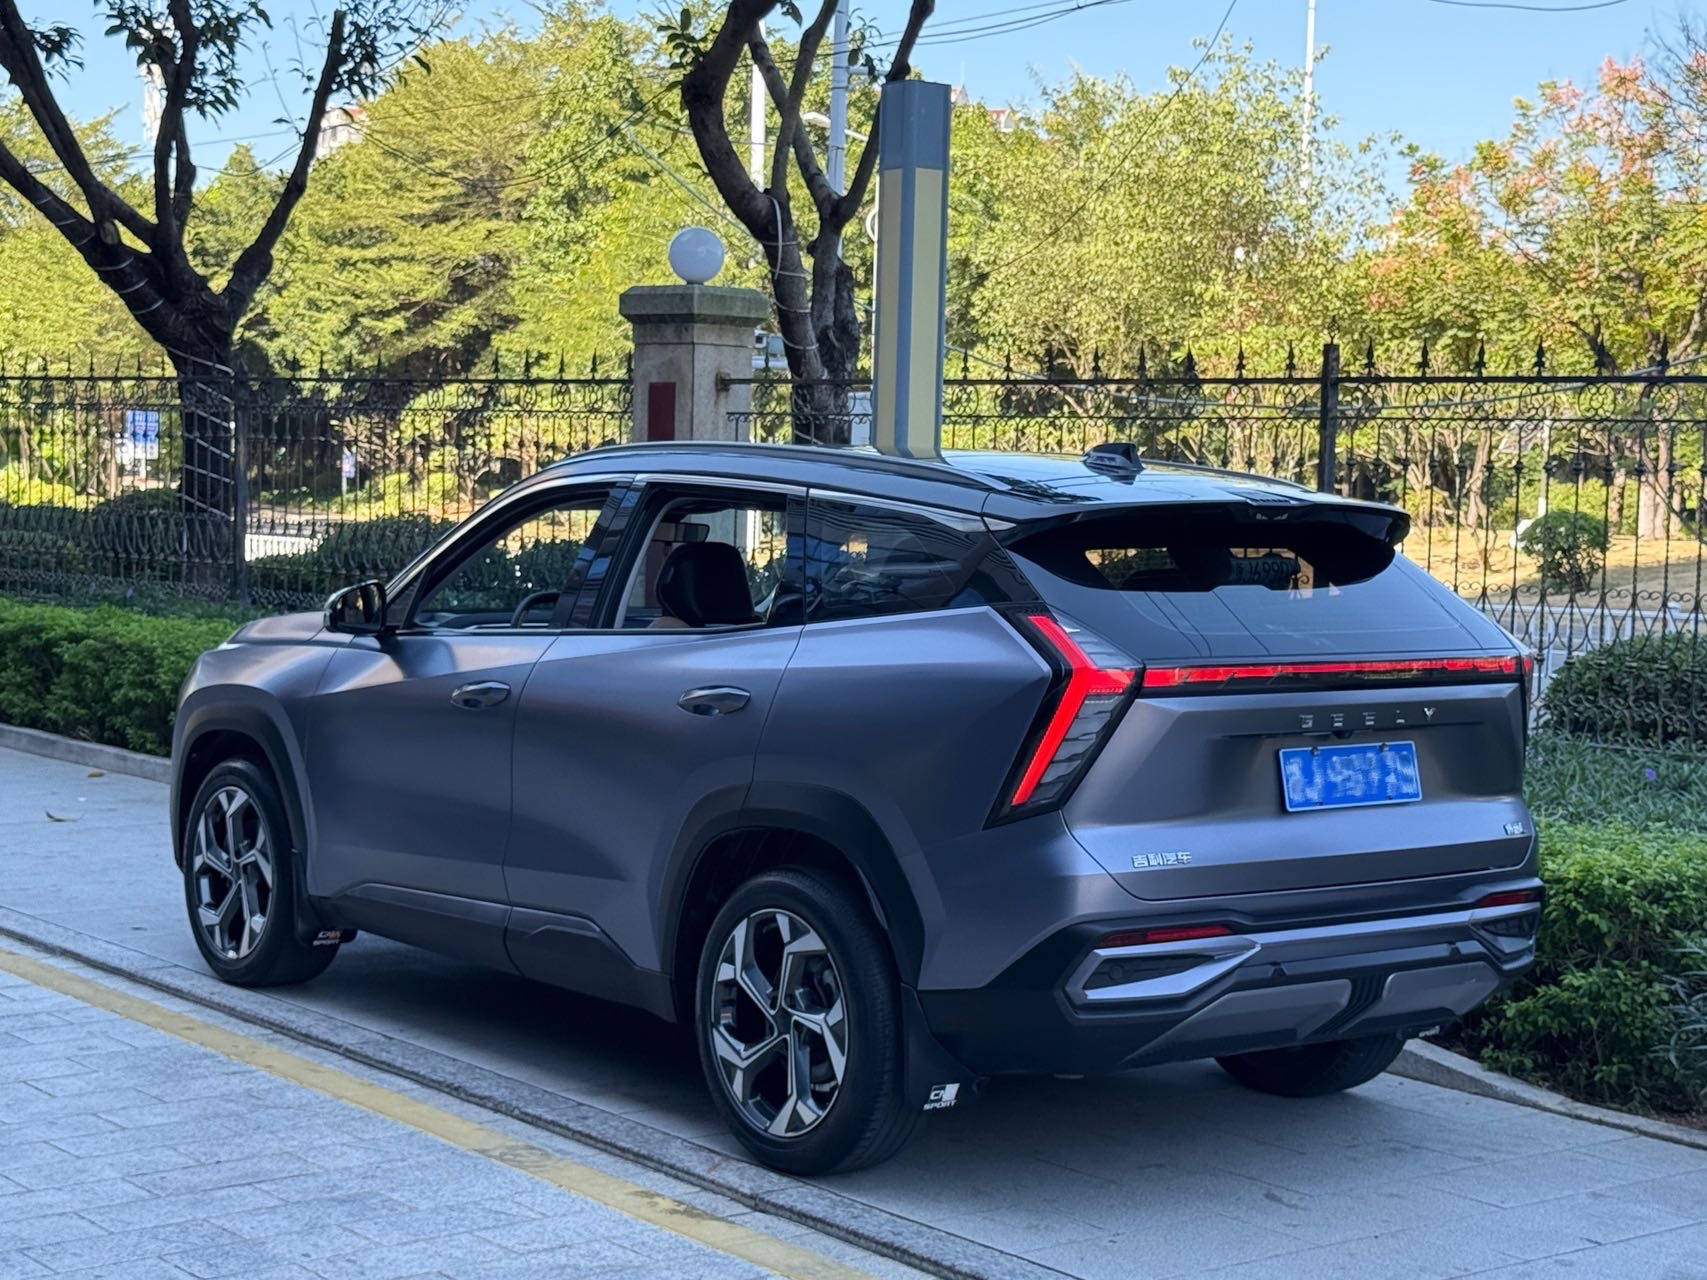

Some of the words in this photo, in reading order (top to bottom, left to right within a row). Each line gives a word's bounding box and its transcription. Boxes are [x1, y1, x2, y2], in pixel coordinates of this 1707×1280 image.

[1299, 707, 1436, 728] GEELY
[1132, 851, 1192, 868] 吉利汽车
